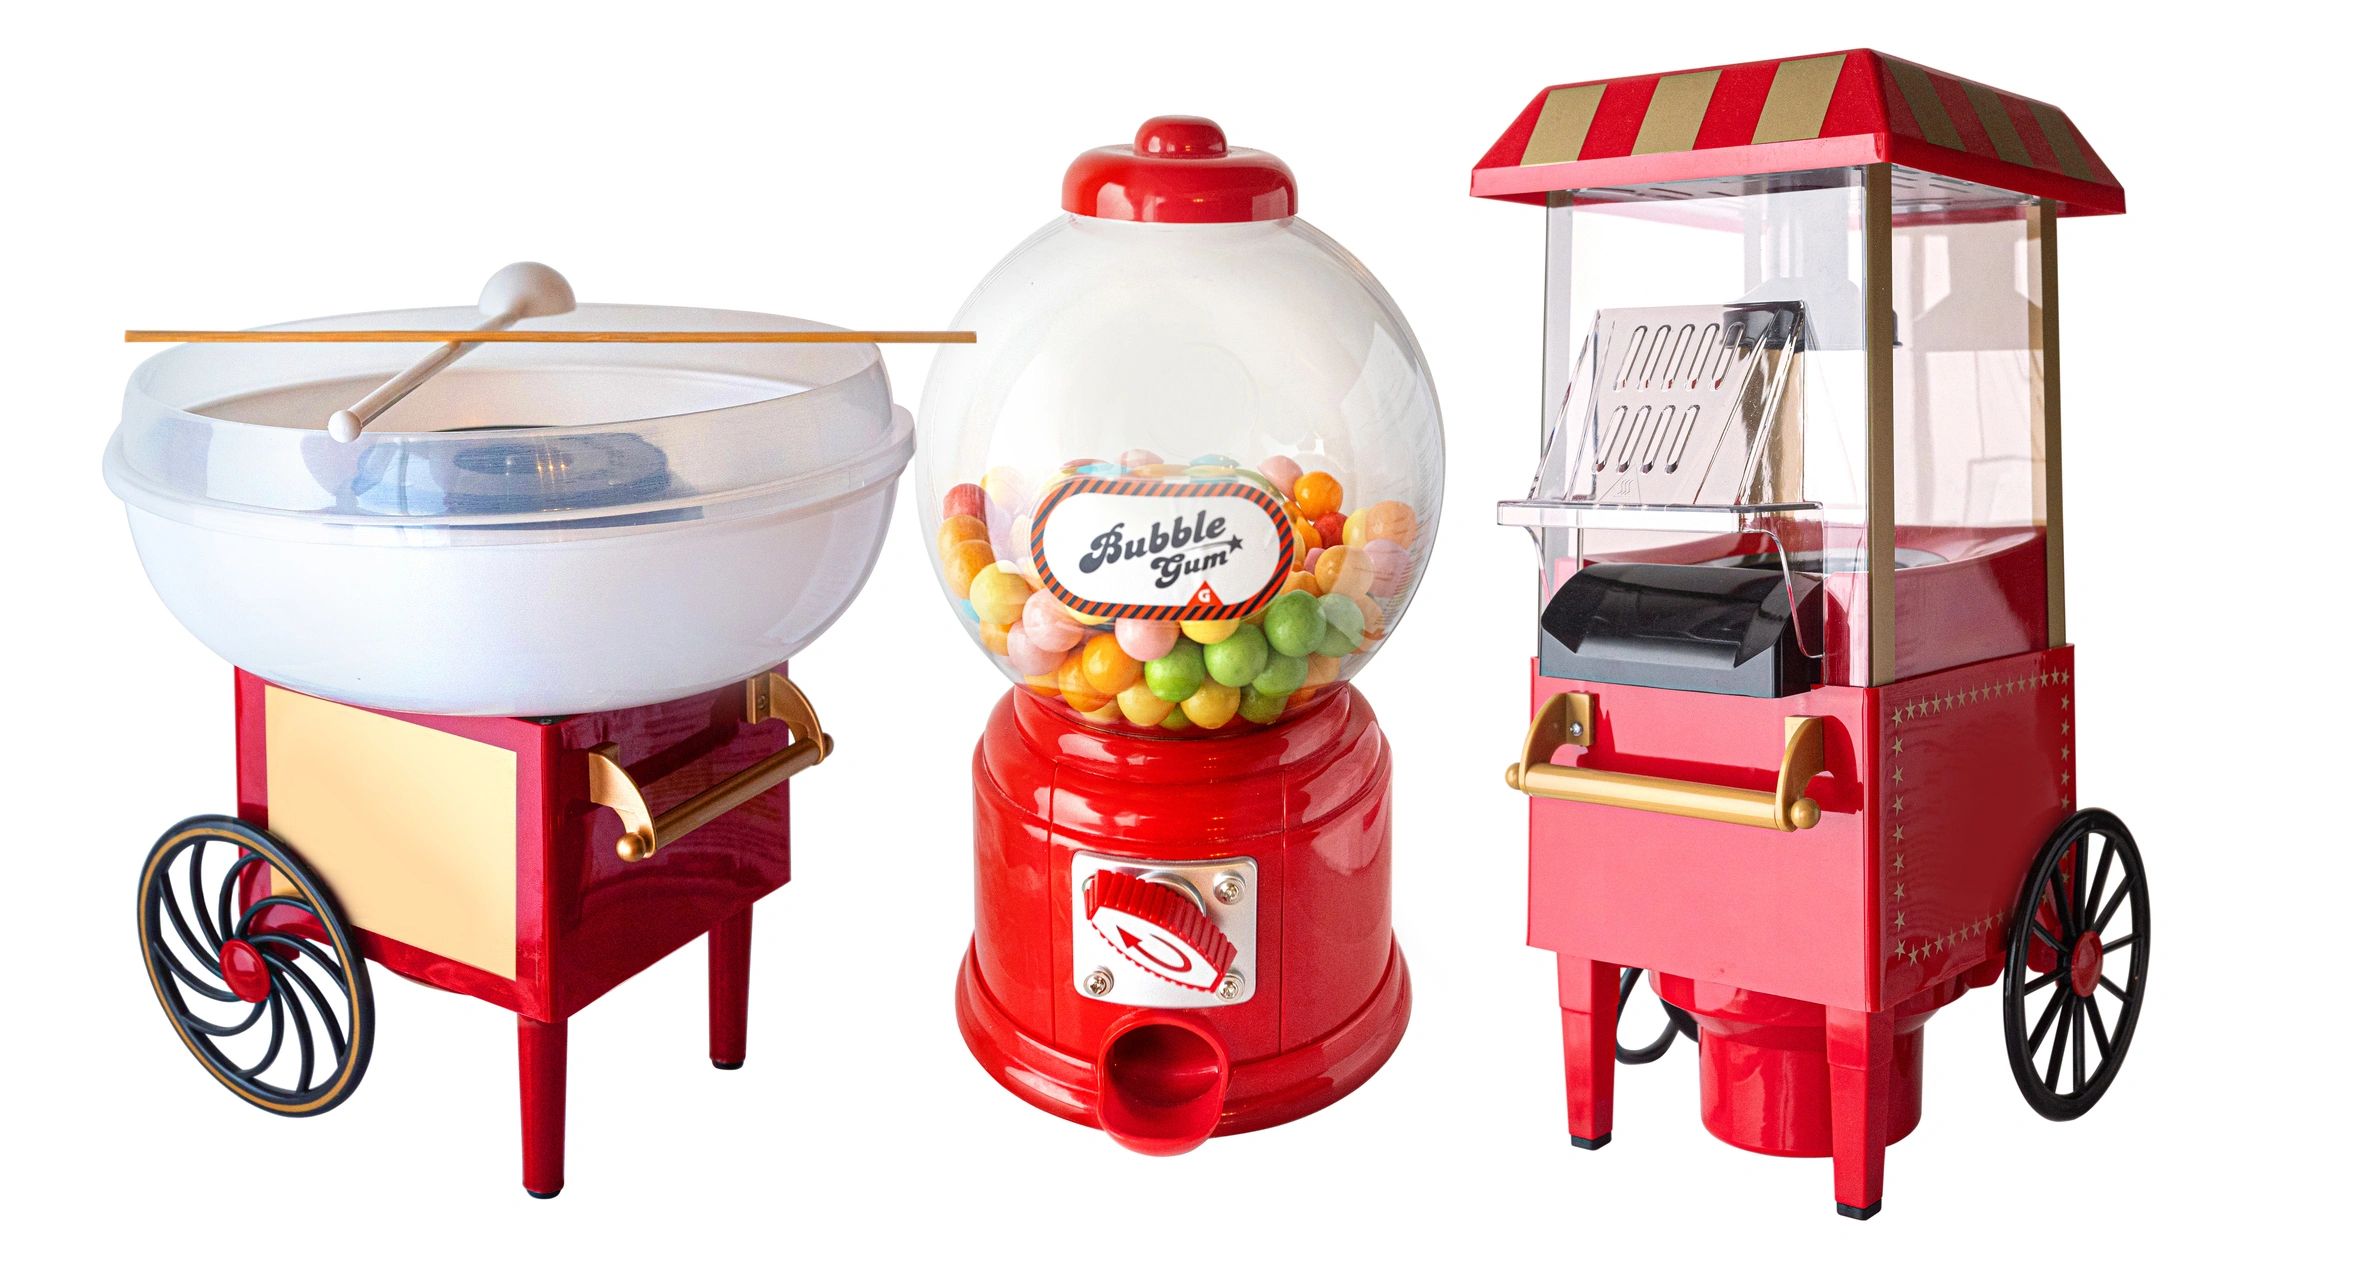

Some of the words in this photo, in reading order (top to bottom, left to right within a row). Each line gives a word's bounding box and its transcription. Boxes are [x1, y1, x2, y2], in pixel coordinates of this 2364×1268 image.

[1079, 510, 1226, 573] Bubble
[1151, 551, 1228, 589] Gum
[1198, 589, 1211, 603] G
